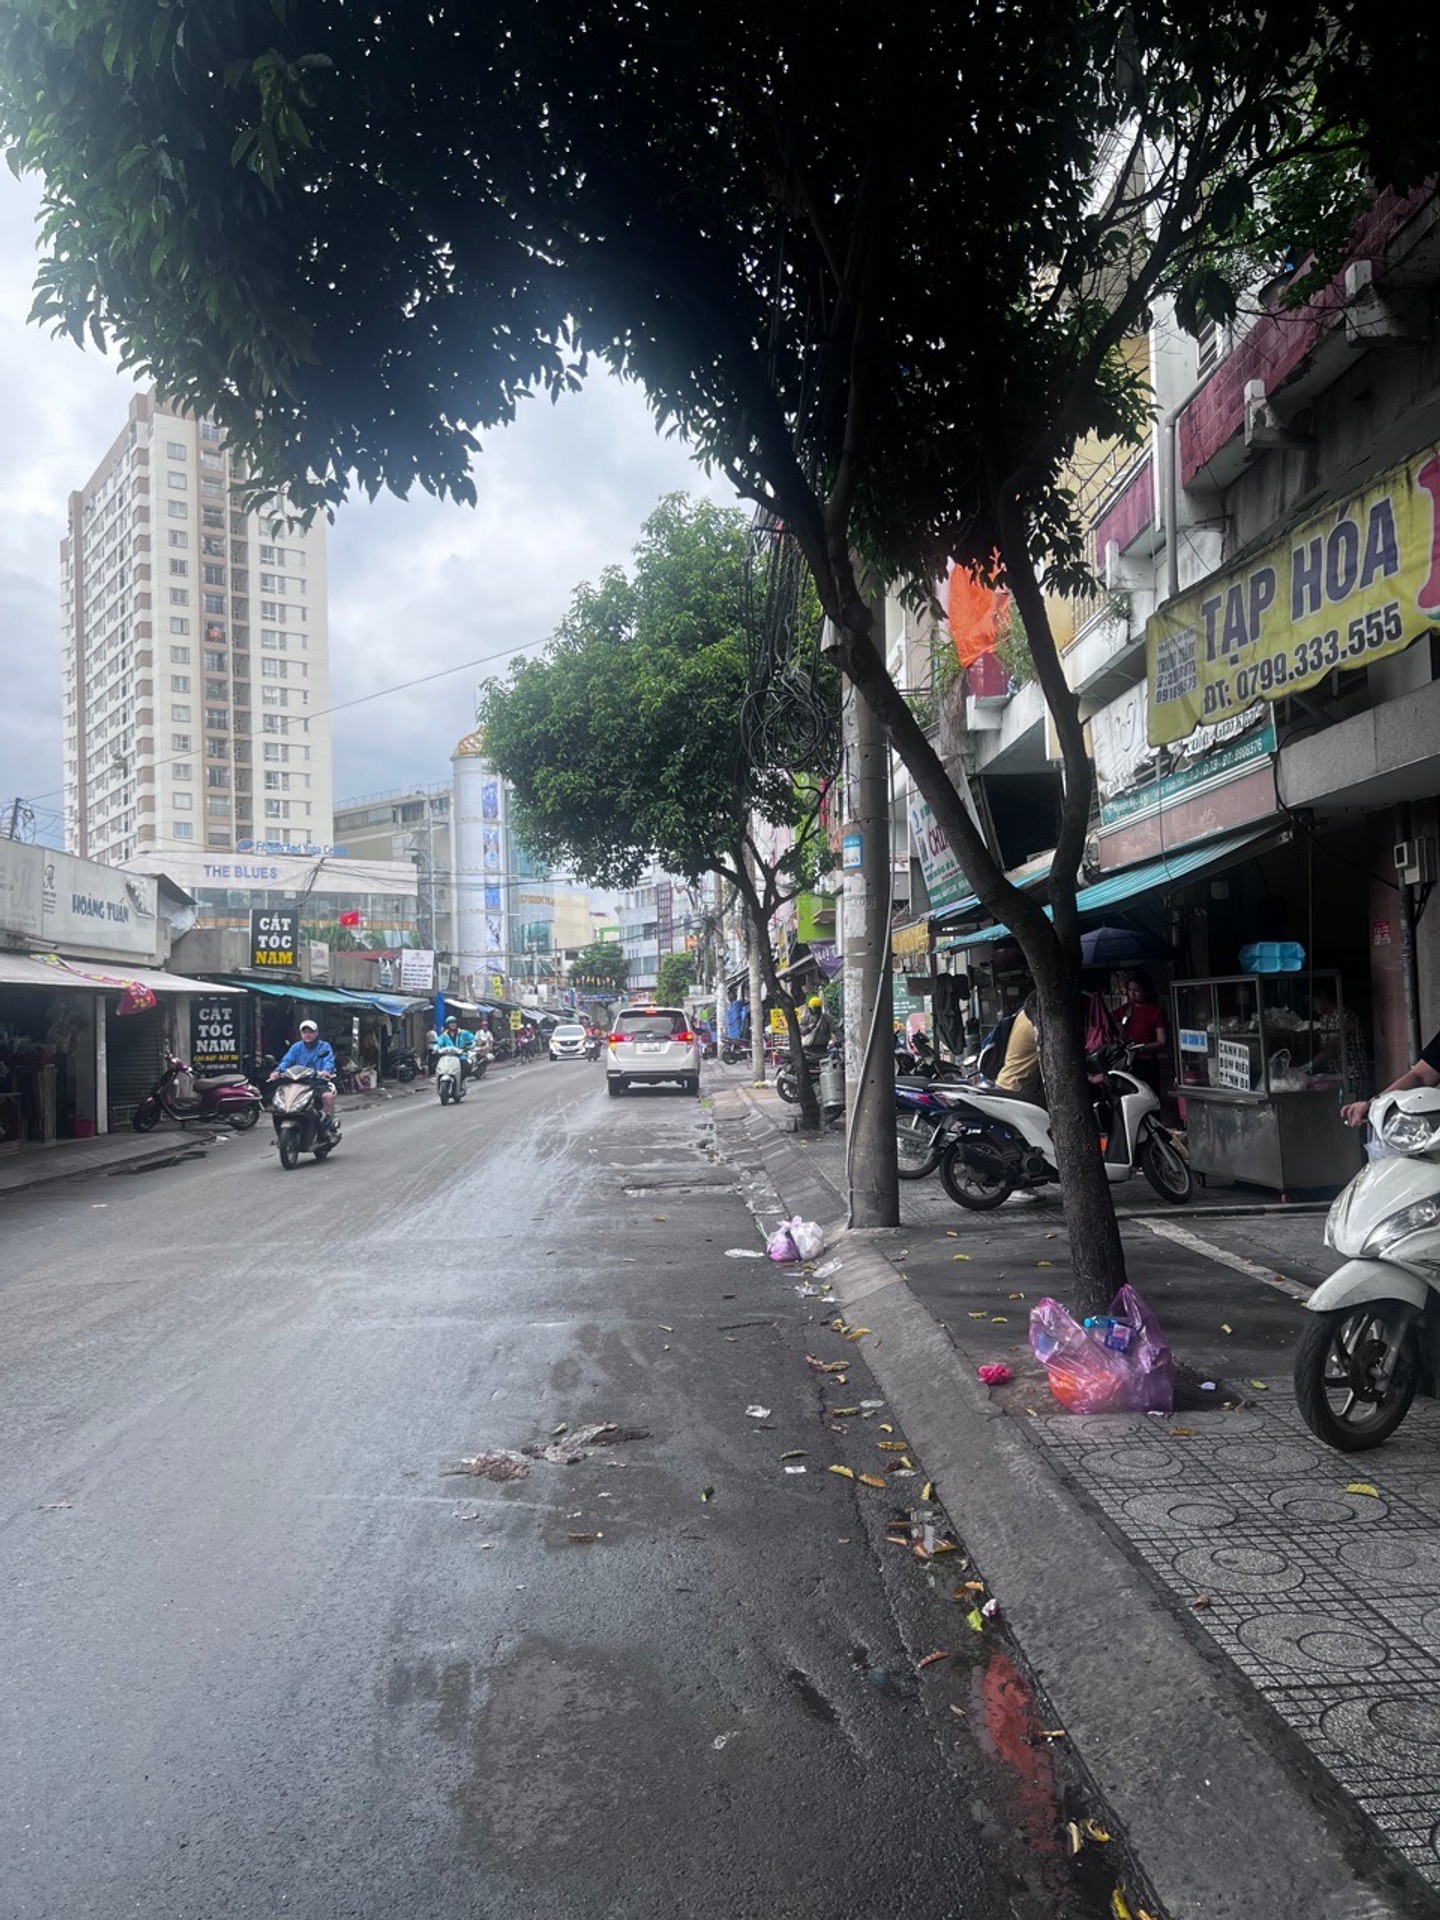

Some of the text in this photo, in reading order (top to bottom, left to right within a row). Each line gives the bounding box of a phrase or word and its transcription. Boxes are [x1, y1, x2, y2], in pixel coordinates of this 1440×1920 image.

[1201, 567, 1277, 666] TẠP
[1291, 497, 1399, 622] HÓA
[1203, 679, 1232, 715] ĐT:
[1236, 601, 1403, 701] 0799.333.555
[204, 864, 278, 879] THE BLUES
[72, 892, 105, 920] HOÀNG
[259, 912, 292, 931] CẮT
[258, 932, 292, 948] TÓC
[255, 951, 293, 965] NAM
[198, 1021, 233, 1037] TÓC
[196, 1039, 236, 1053] NAM
